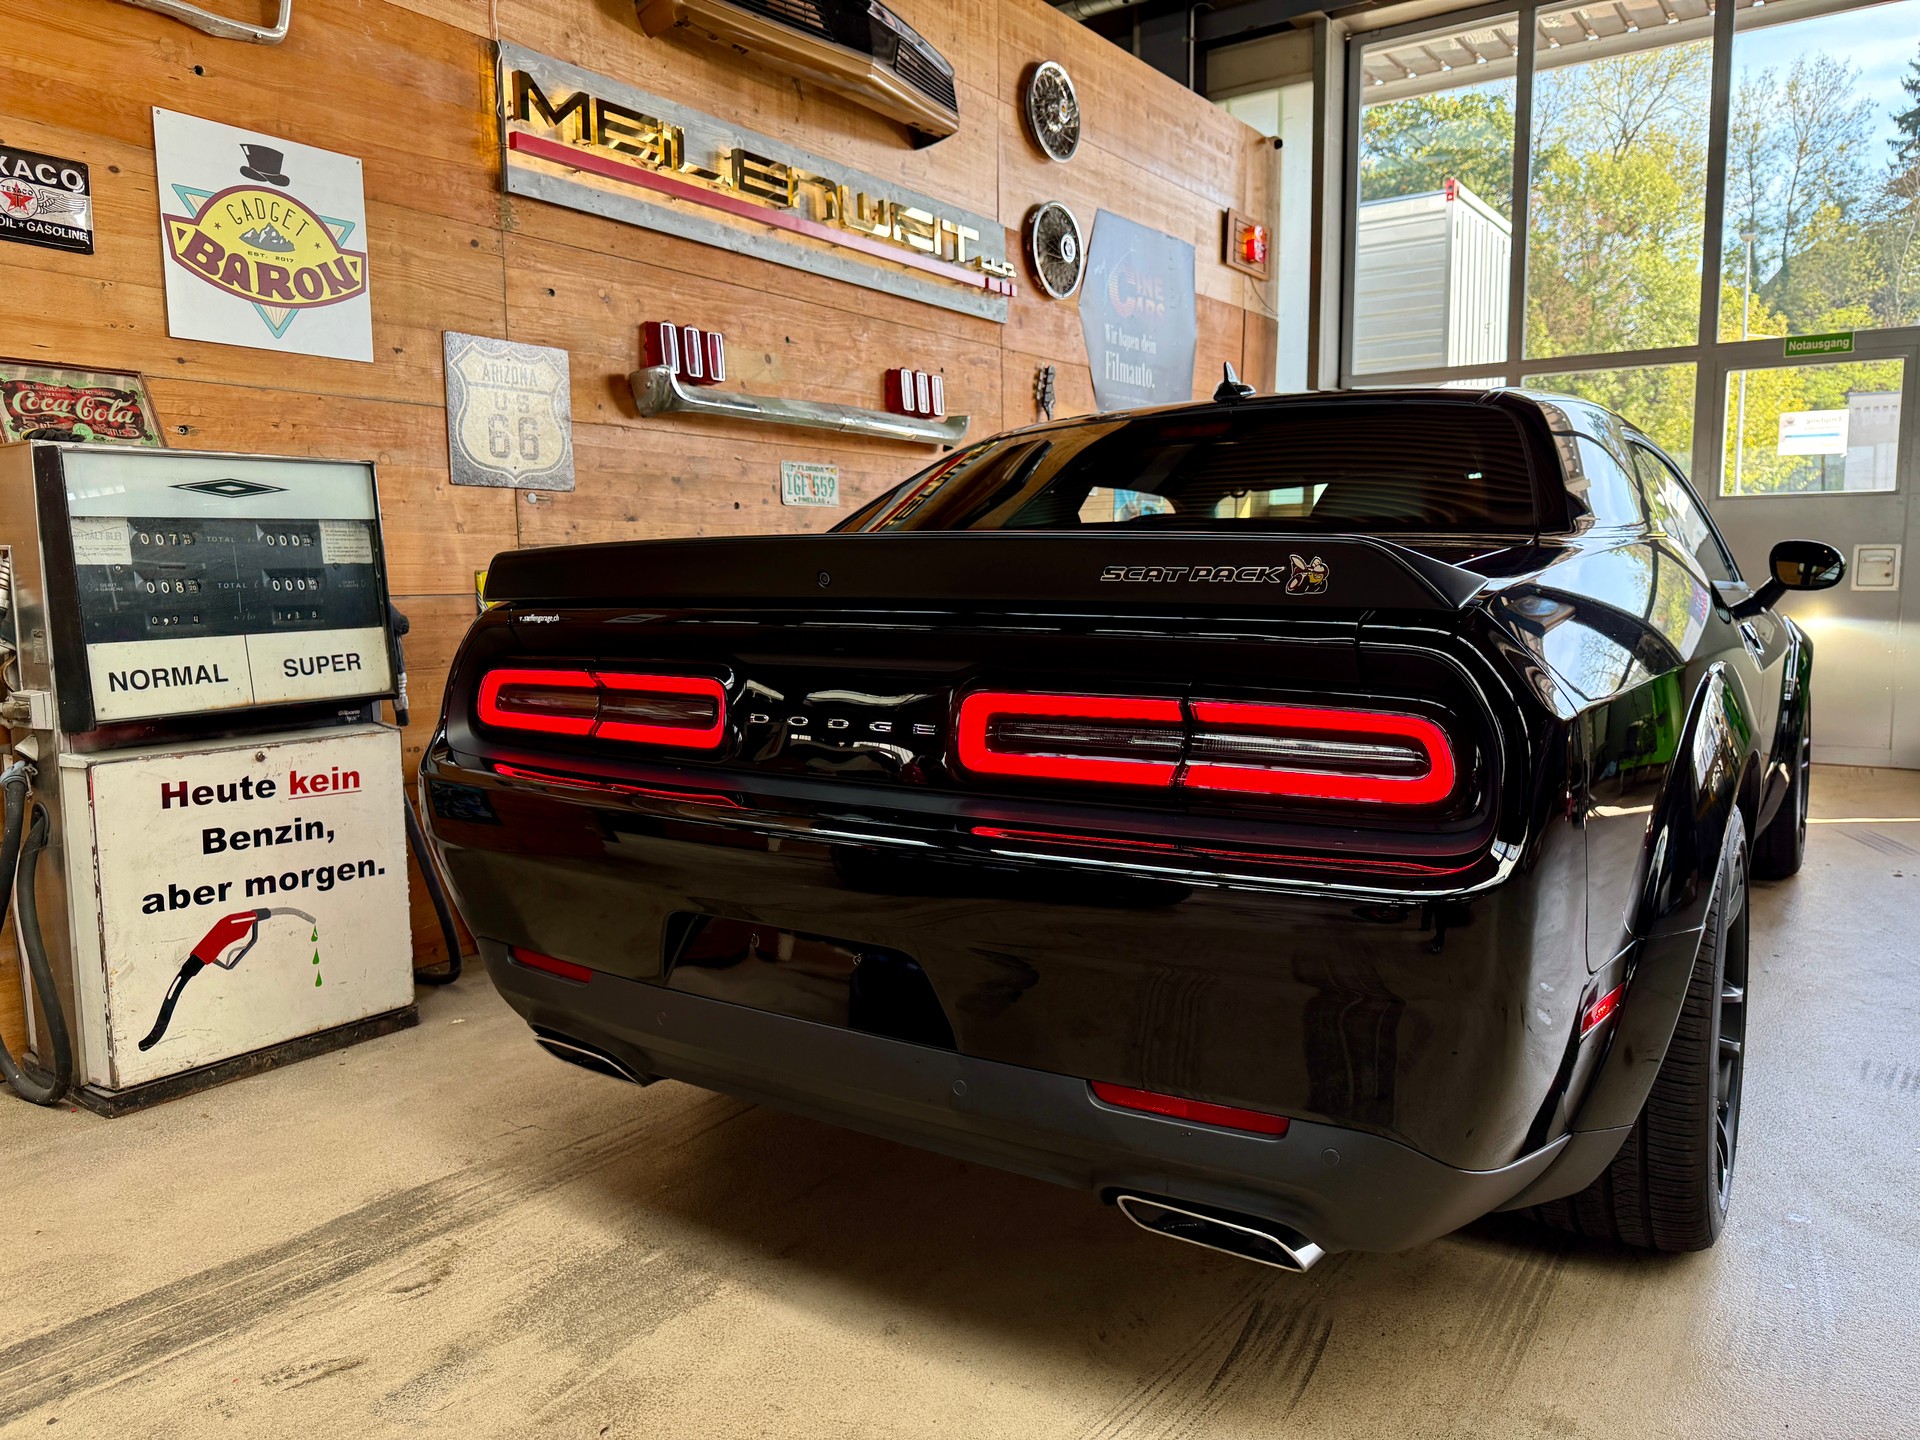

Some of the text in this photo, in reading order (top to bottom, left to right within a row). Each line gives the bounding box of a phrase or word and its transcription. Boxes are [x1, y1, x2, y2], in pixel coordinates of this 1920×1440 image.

[1, 184, 34, 196] TEXACO
[226, 197, 310, 237] GADGET
[26, 221, 89, 241] GASOLINE
[178, 228, 360, 300] BARON
[247, 250, 269, 259] EST.
[1104, 323, 1118, 345] Wir
[1788, 337, 1850, 351] Notausgang
[482, 363, 538, 387] ARIZONA
[1105, 350, 1155, 389] Filmauto.
[488, 414, 540, 461] 66
[812, 474, 836, 498] 559
[1100, 566, 1286, 584] SCAT PACK
[283, 652, 362, 678] SUPER
[108, 664, 229, 693] NORMAL
[750, 713, 936, 735] DODGE
[161, 766, 361, 810] Heute kein
[202, 817, 335, 855] Benzin,
[141, 859, 386, 915] aber morgen.
